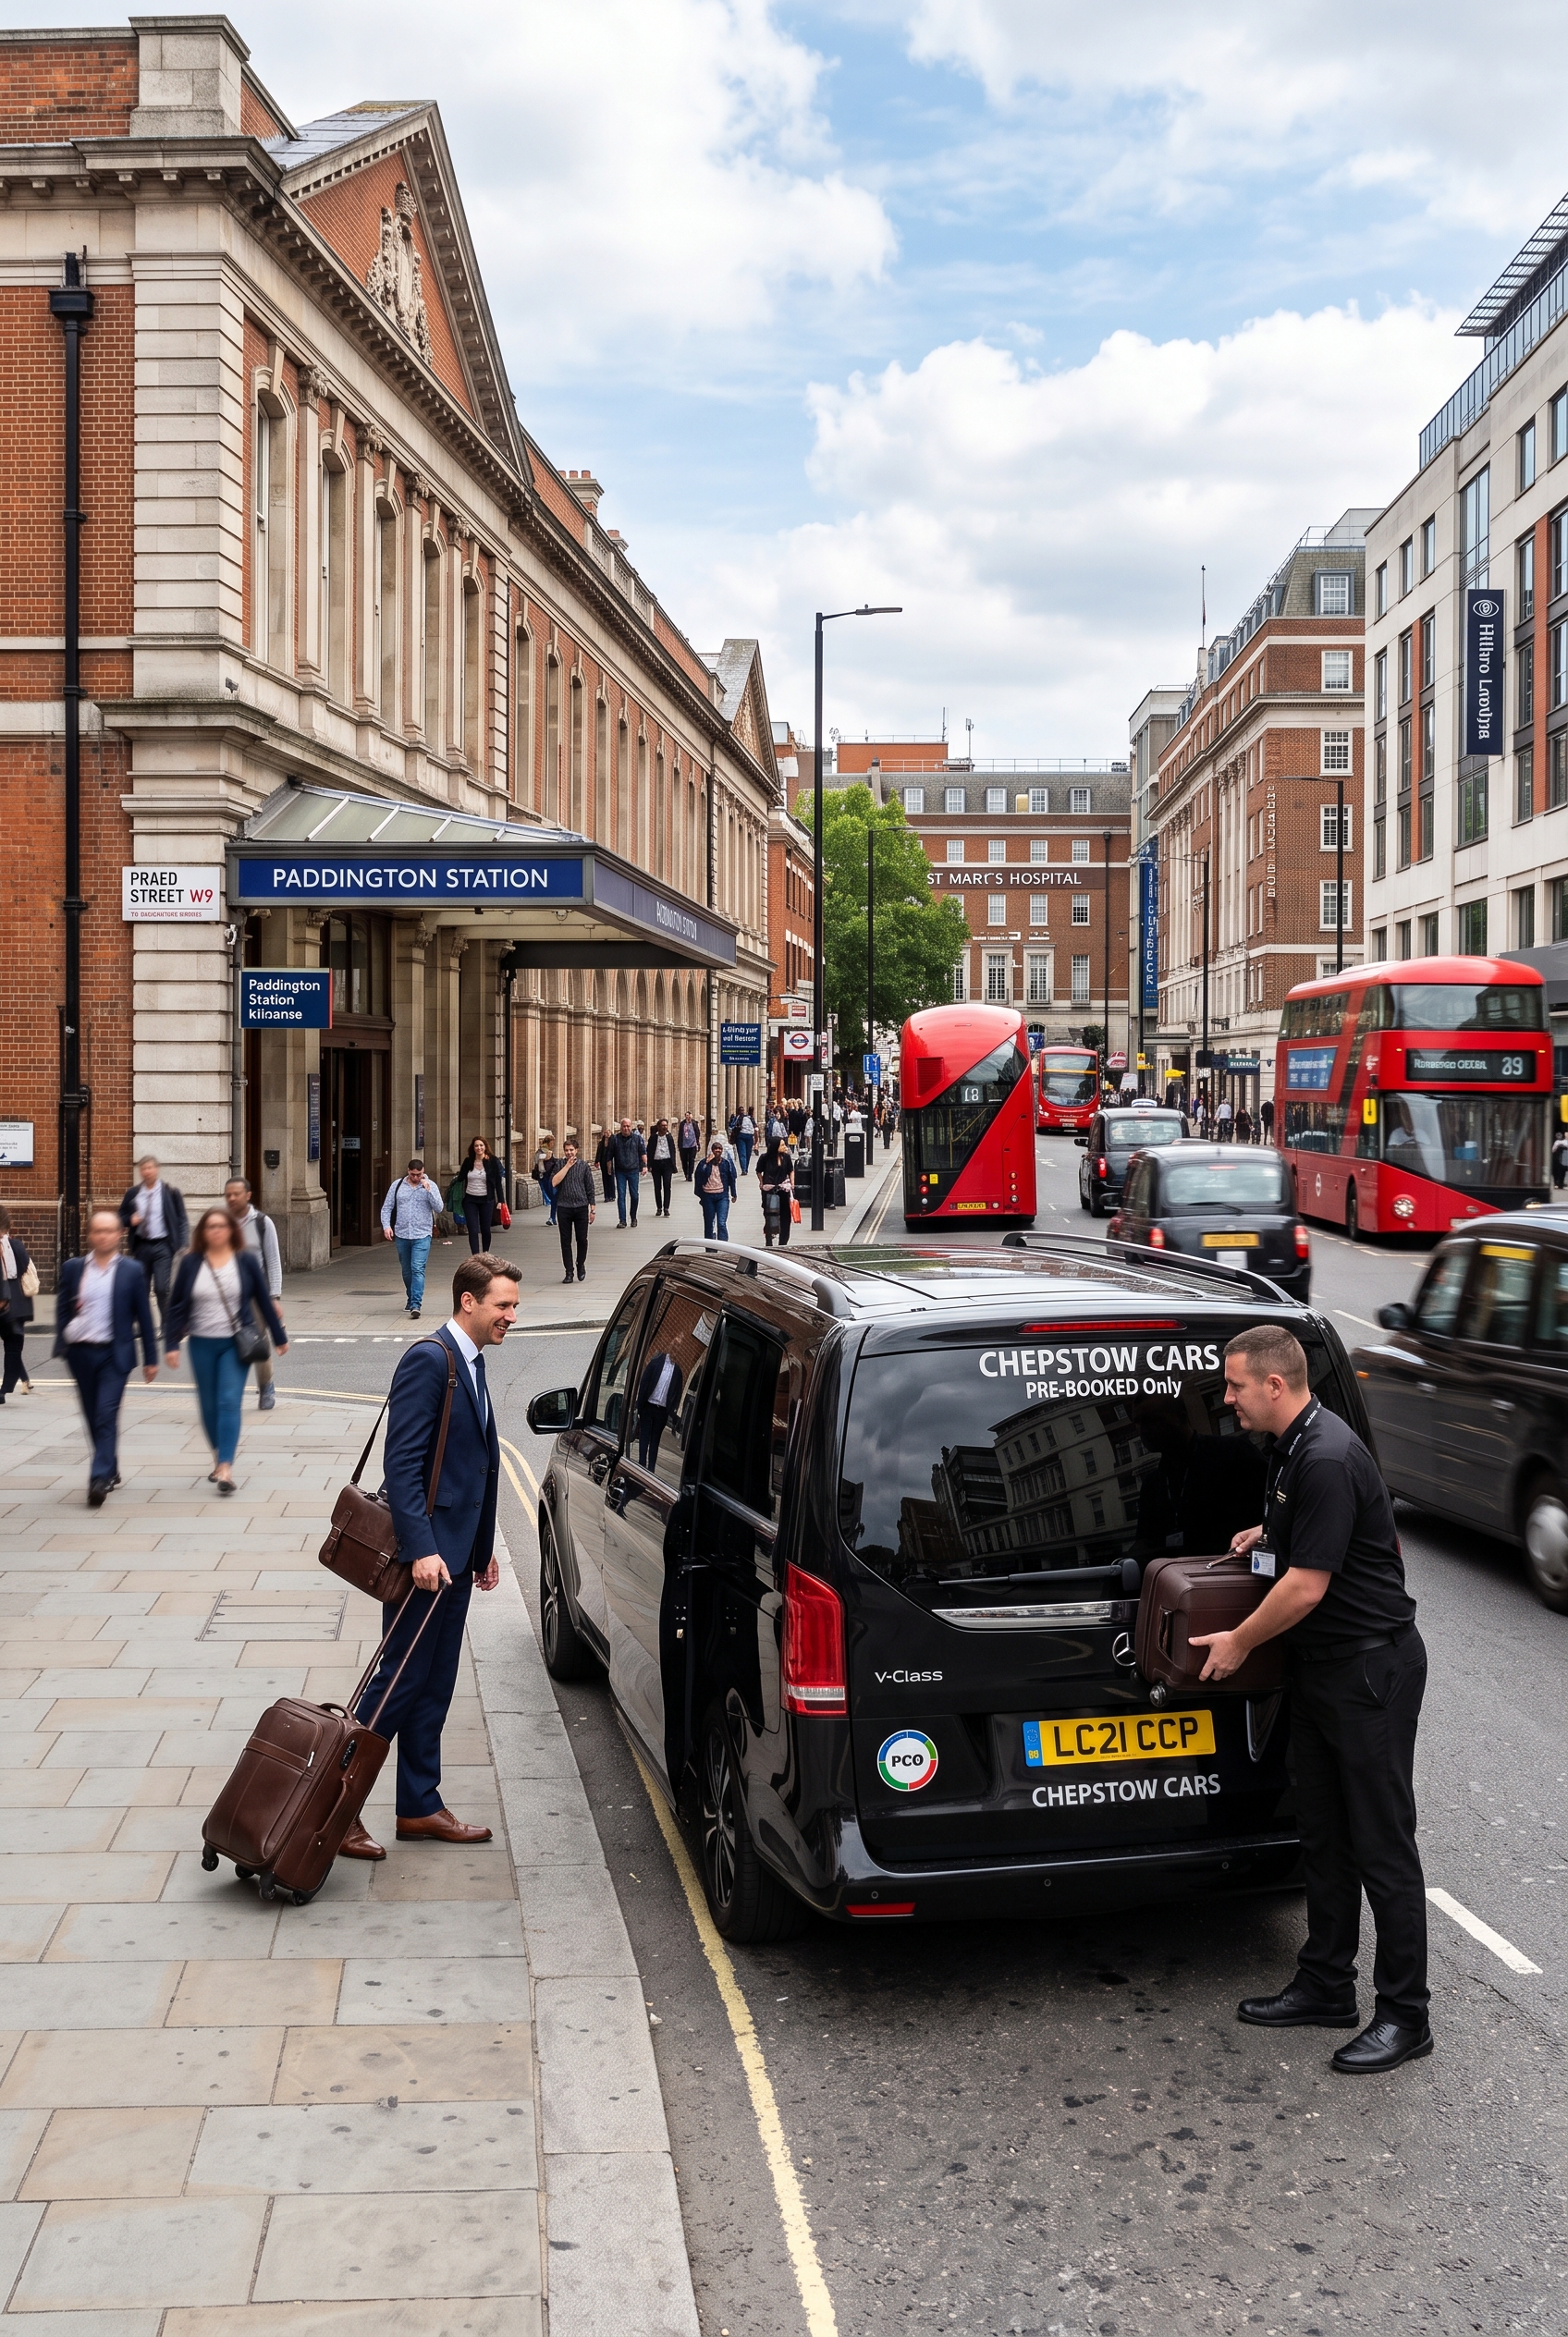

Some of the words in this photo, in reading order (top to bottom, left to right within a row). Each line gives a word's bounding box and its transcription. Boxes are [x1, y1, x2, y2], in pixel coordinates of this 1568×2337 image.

[130, 872, 178, 886] PRAED
[273, 868, 436, 887] PADDINGTON
[446, 868, 548, 888] STATION
[926, 873, 943, 885] ST
[1010, 873, 1082, 885] HOSPITAL
[130, 889, 184, 903] STREET
[190, 889, 214, 903] W9
[249, 978, 321, 994] Paddington
[249, 994, 295, 1005] Station
[978, 1346, 1138, 1377] CHEPSTOW
[1145, 1344, 1220, 1372] CARS
[1025, 1378, 1139, 1399] PRE-BOOKED
[1143, 1376, 1182, 1398] Only
[1136, 1717, 1198, 1751] CCP
[891, 1754, 924, 1767] PCO
[1032, 1779, 1158, 1807] CHEPSTOW
[1163, 1773, 1220, 1798] CARS
